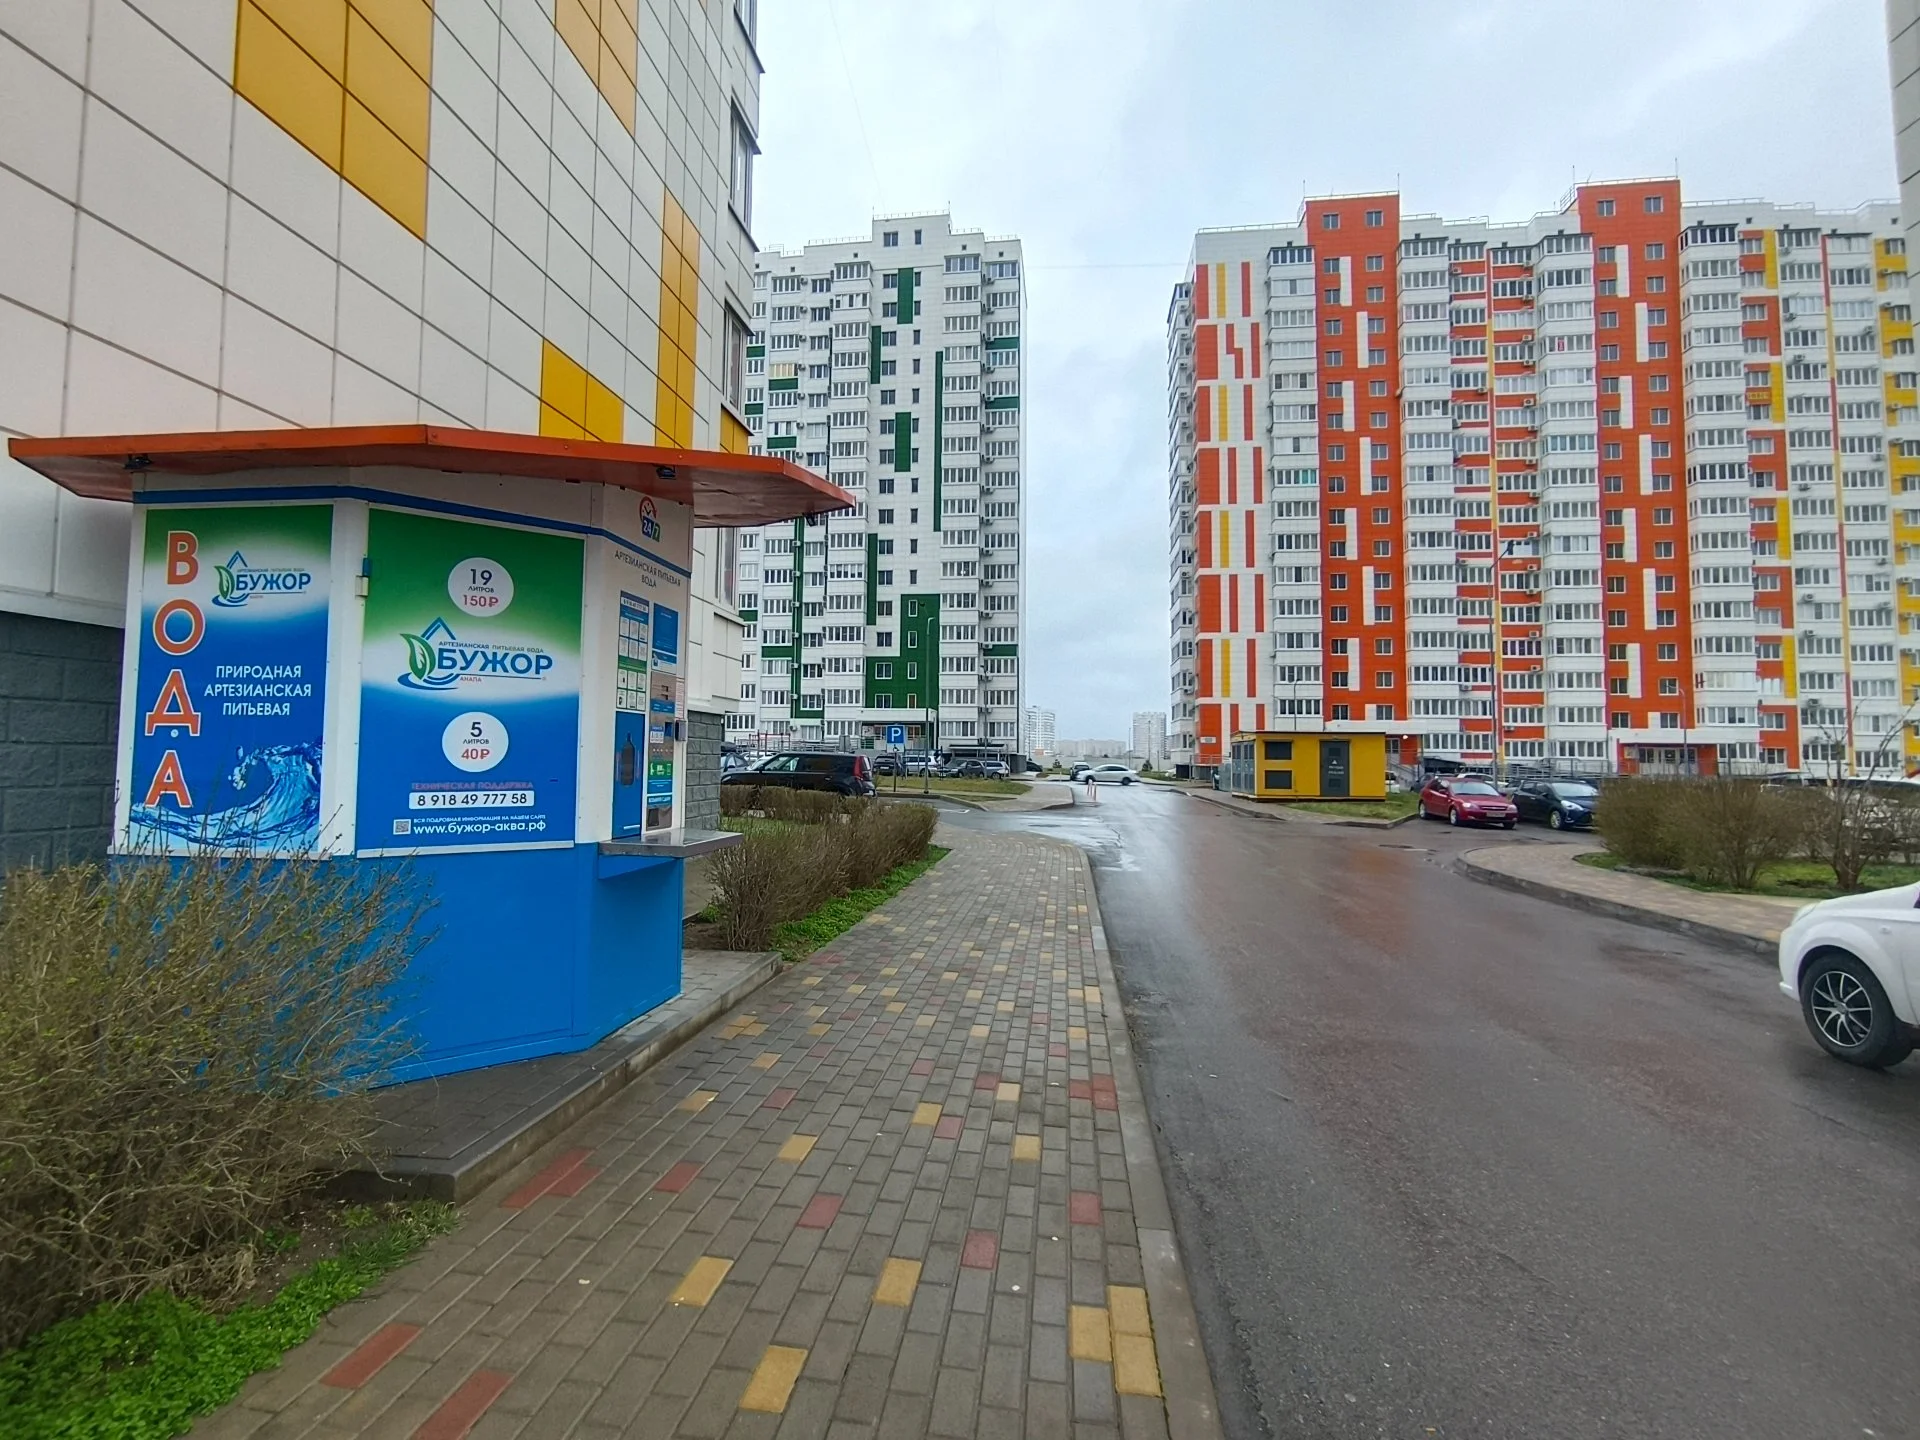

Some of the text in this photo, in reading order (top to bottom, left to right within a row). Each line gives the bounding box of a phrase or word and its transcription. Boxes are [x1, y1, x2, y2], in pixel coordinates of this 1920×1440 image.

[615, 550, 681, 587] АРТЕЗИАНСКАЯ ПИТЬЕВАЯ
[236, 572, 312, 591] БУЖОР
[470, 568, 493, 585] 19
[641, 574, 657, 588] ВОДА
[438, 640, 490, 650] АРТЕЗИАНСКАЯ
[491, 644, 525, 652] ПИТЬЕВАЯ
[437, 647, 553, 675] БУЖОР
[144, 530, 206, 808] ВОДА
[215, 665, 302, 680] ПРИРОДНАЯ
[203, 683, 312, 697] АРТЕЗИАНСКАЯ
[222, 702, 291, 716] ПИТЬЕВАЯ
[470, 721, 483, 738] 5
[411, 781, 534, 791] ТЕХНИЧЕСКАЯ ПОДДЕРЖКА
[417, 792, 527, 806] 8 918 49 777 58
[413, 820, 546, 834] www.бужор-аква.рф
